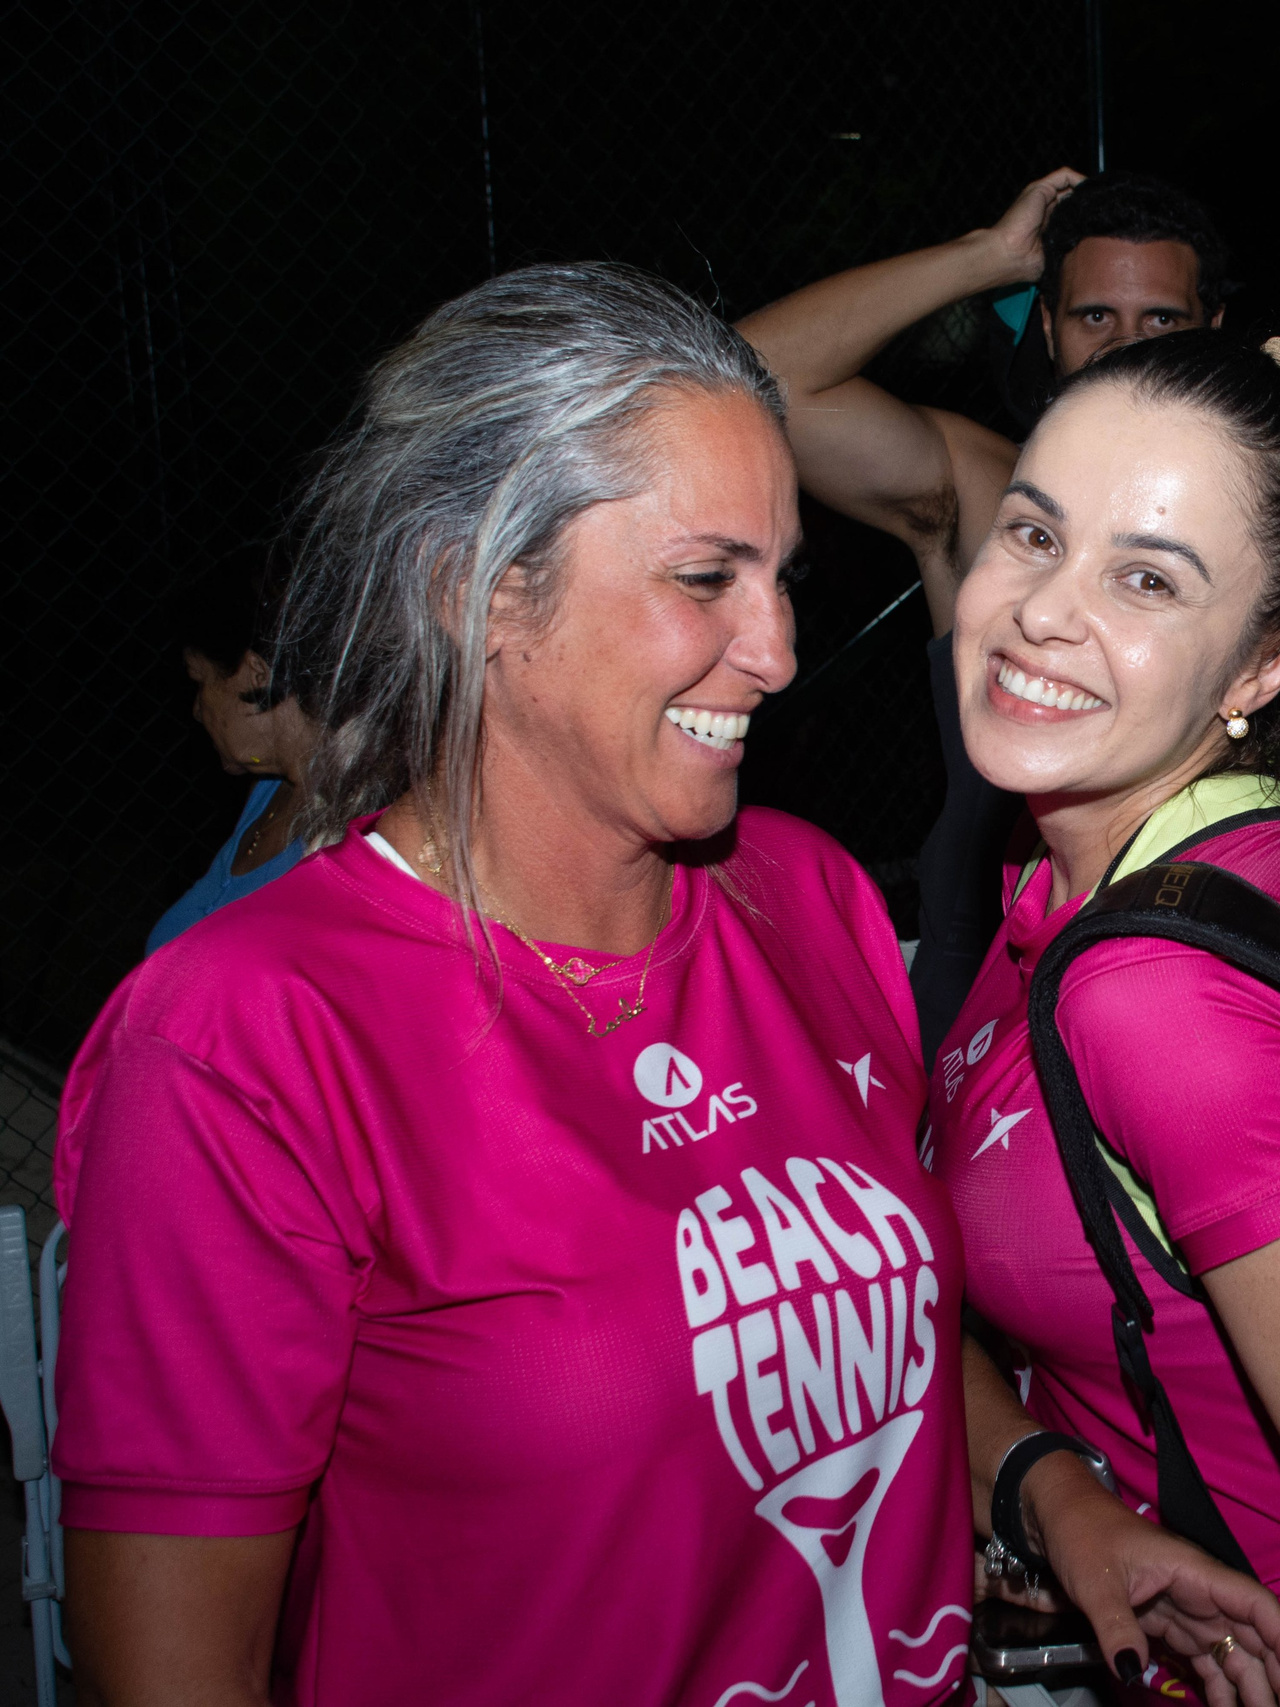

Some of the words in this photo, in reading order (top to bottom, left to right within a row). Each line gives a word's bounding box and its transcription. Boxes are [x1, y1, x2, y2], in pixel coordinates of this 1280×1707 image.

[641, 1082, 758, 1154] ATLAS
[676, 1157, 935, 1329] BEACH
[692, 1264, 939, 1491] TENNIS
